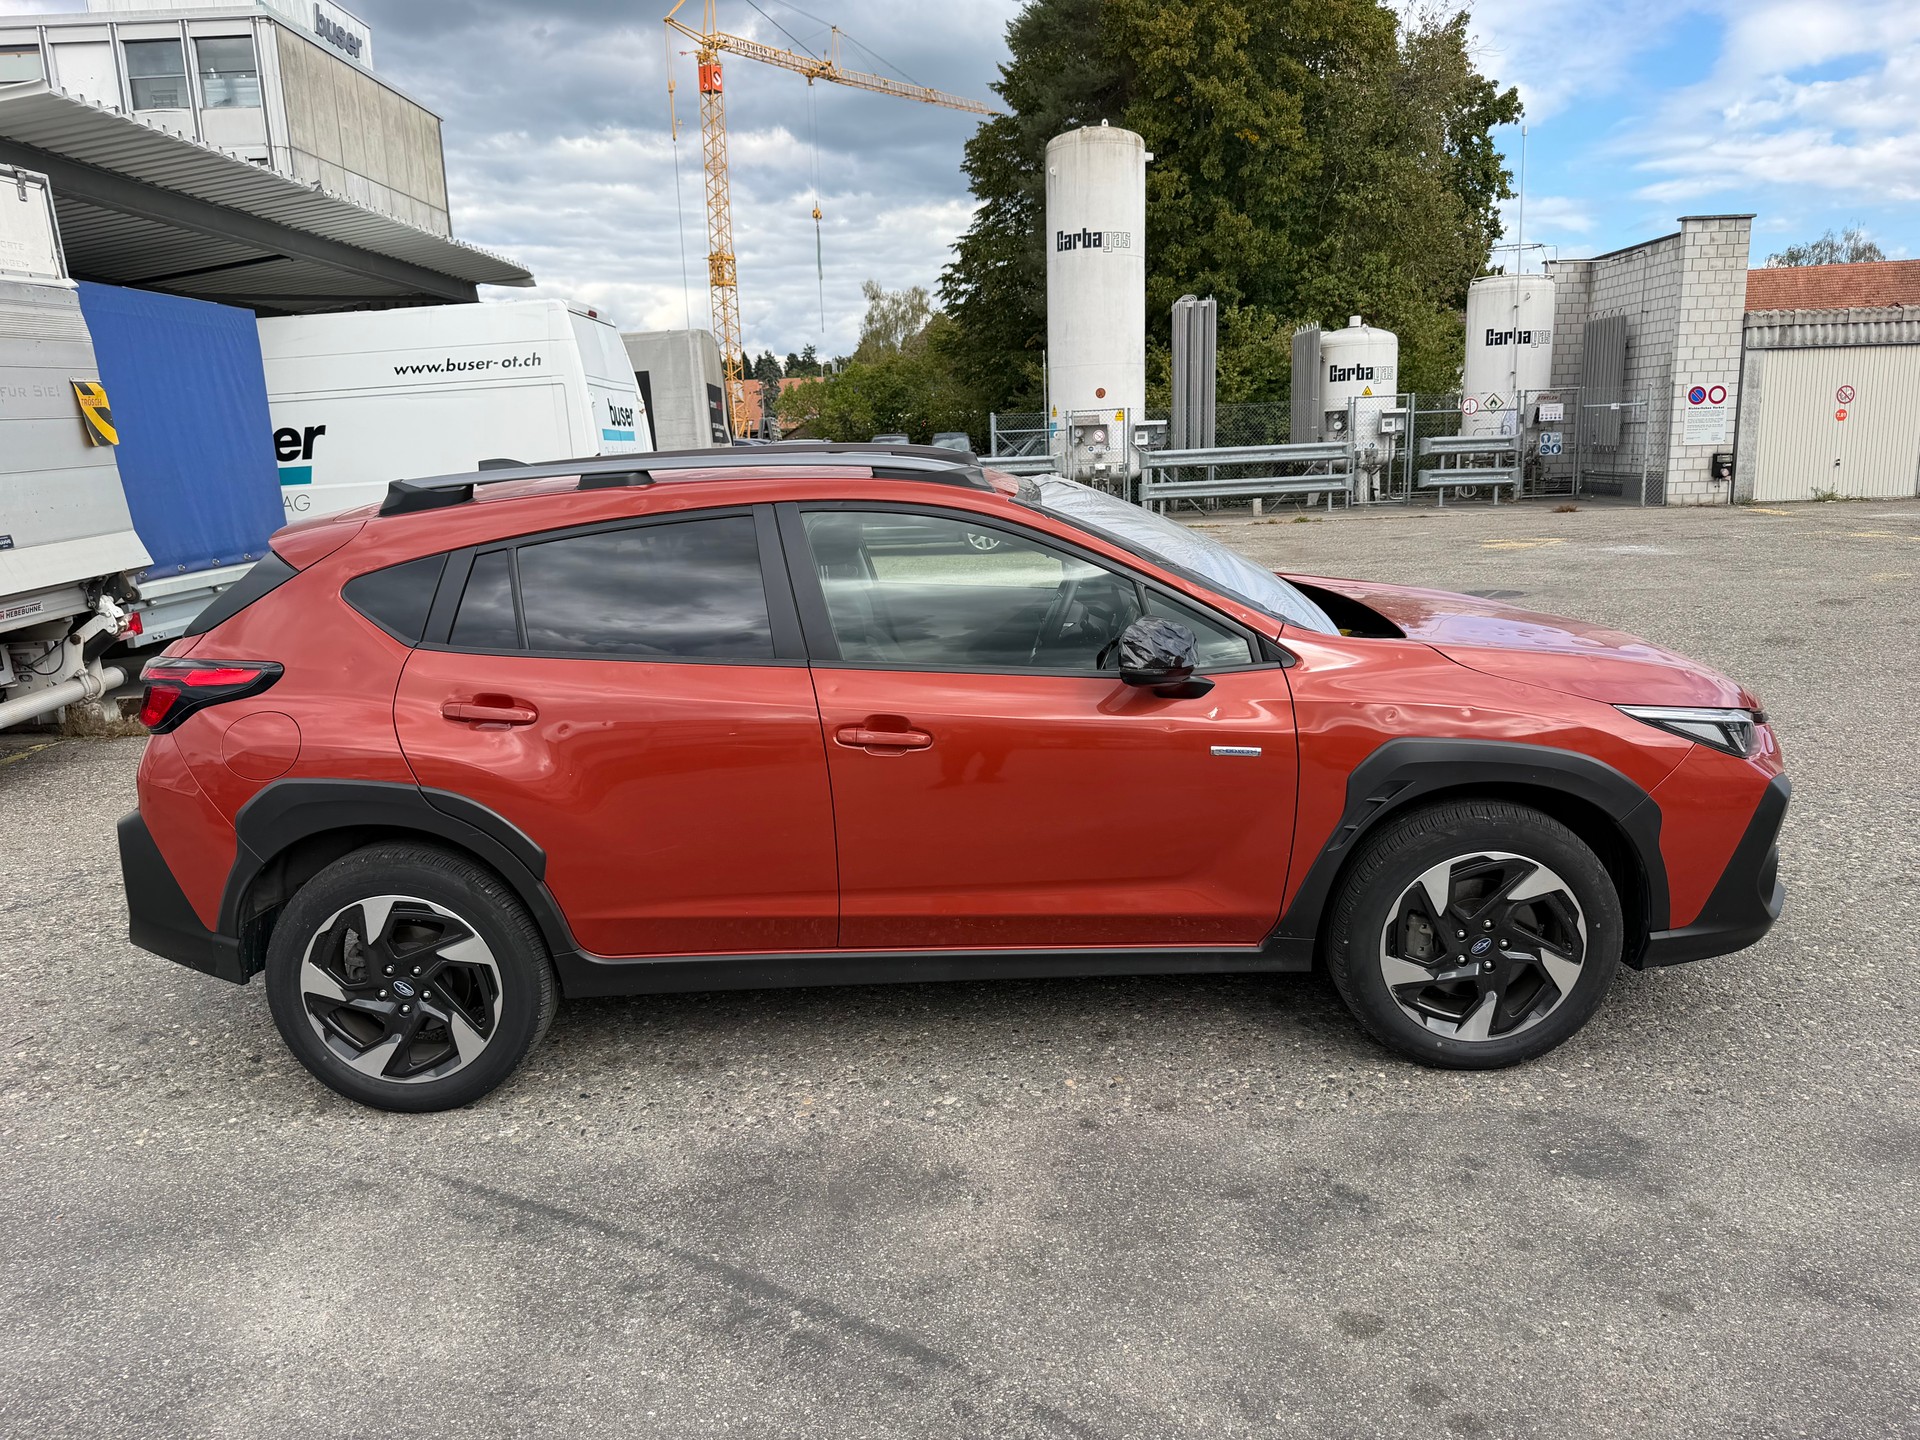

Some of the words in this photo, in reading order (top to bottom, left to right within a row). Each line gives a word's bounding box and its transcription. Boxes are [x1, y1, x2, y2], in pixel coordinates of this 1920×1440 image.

[313, 2, 363, 59] buser
[1057, 228, 1131, 253] Carbagas
[1485, 327, 1551, 348] Carbagas
[1329, 363, 1394, 385] Carbagas
[607, 397, 634, 427] buser
[283, 493, 312, 513] AG
